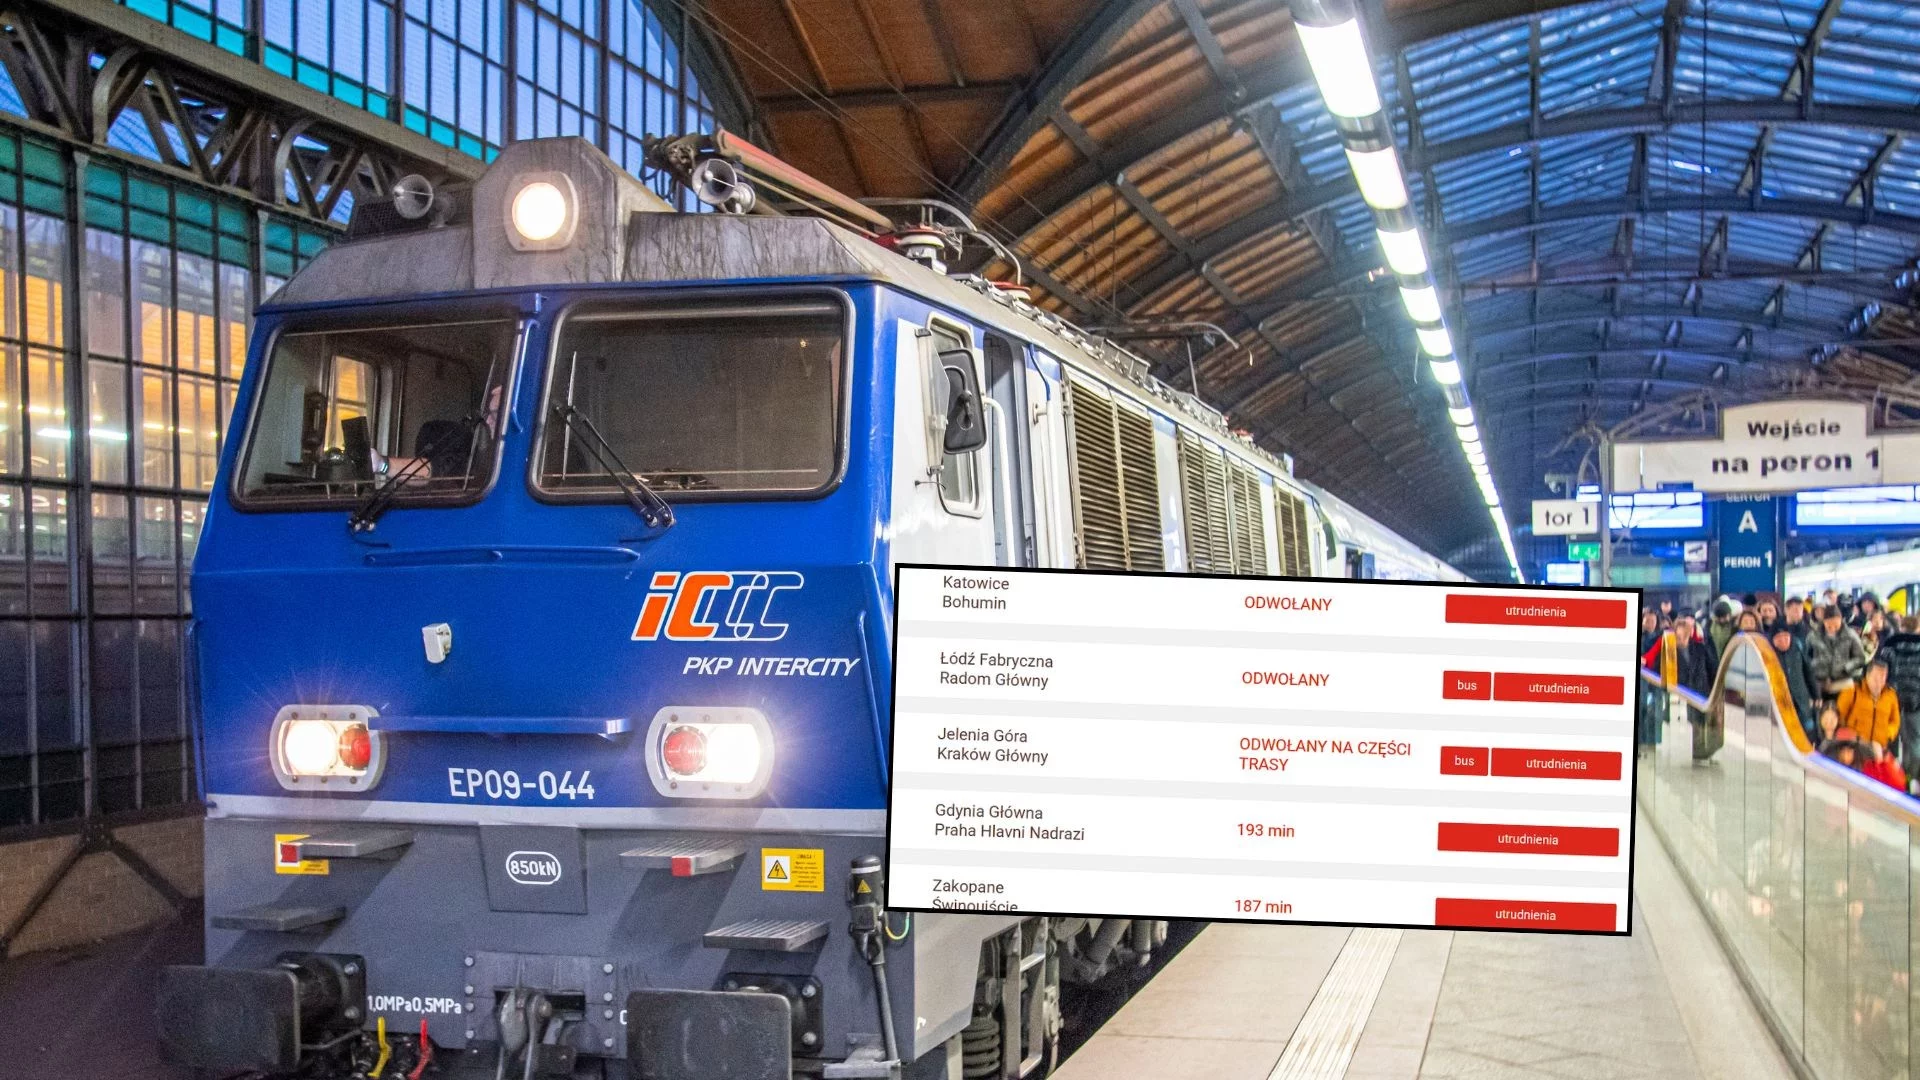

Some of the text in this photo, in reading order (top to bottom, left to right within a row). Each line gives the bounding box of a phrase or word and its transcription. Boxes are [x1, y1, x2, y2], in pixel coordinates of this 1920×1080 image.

[1747, 419, 1841, 441] Wejście
[1711, 447, 1880, 479] na peron 1
[1545, 507, 1590, 526] tor 1
[1738, 510, 1758, 534] A
[1724, 555, 1761, 569] PERON
[1764, 550, 1773, 568] 1
[682, 657, 861, 677] PKP INTERCITY
[448, 768, 595, 800] EP09-044
[510, 860, 557, 876] 850kN
[367, 995, 462, 1015] 1,0MPa 0,5MPa
